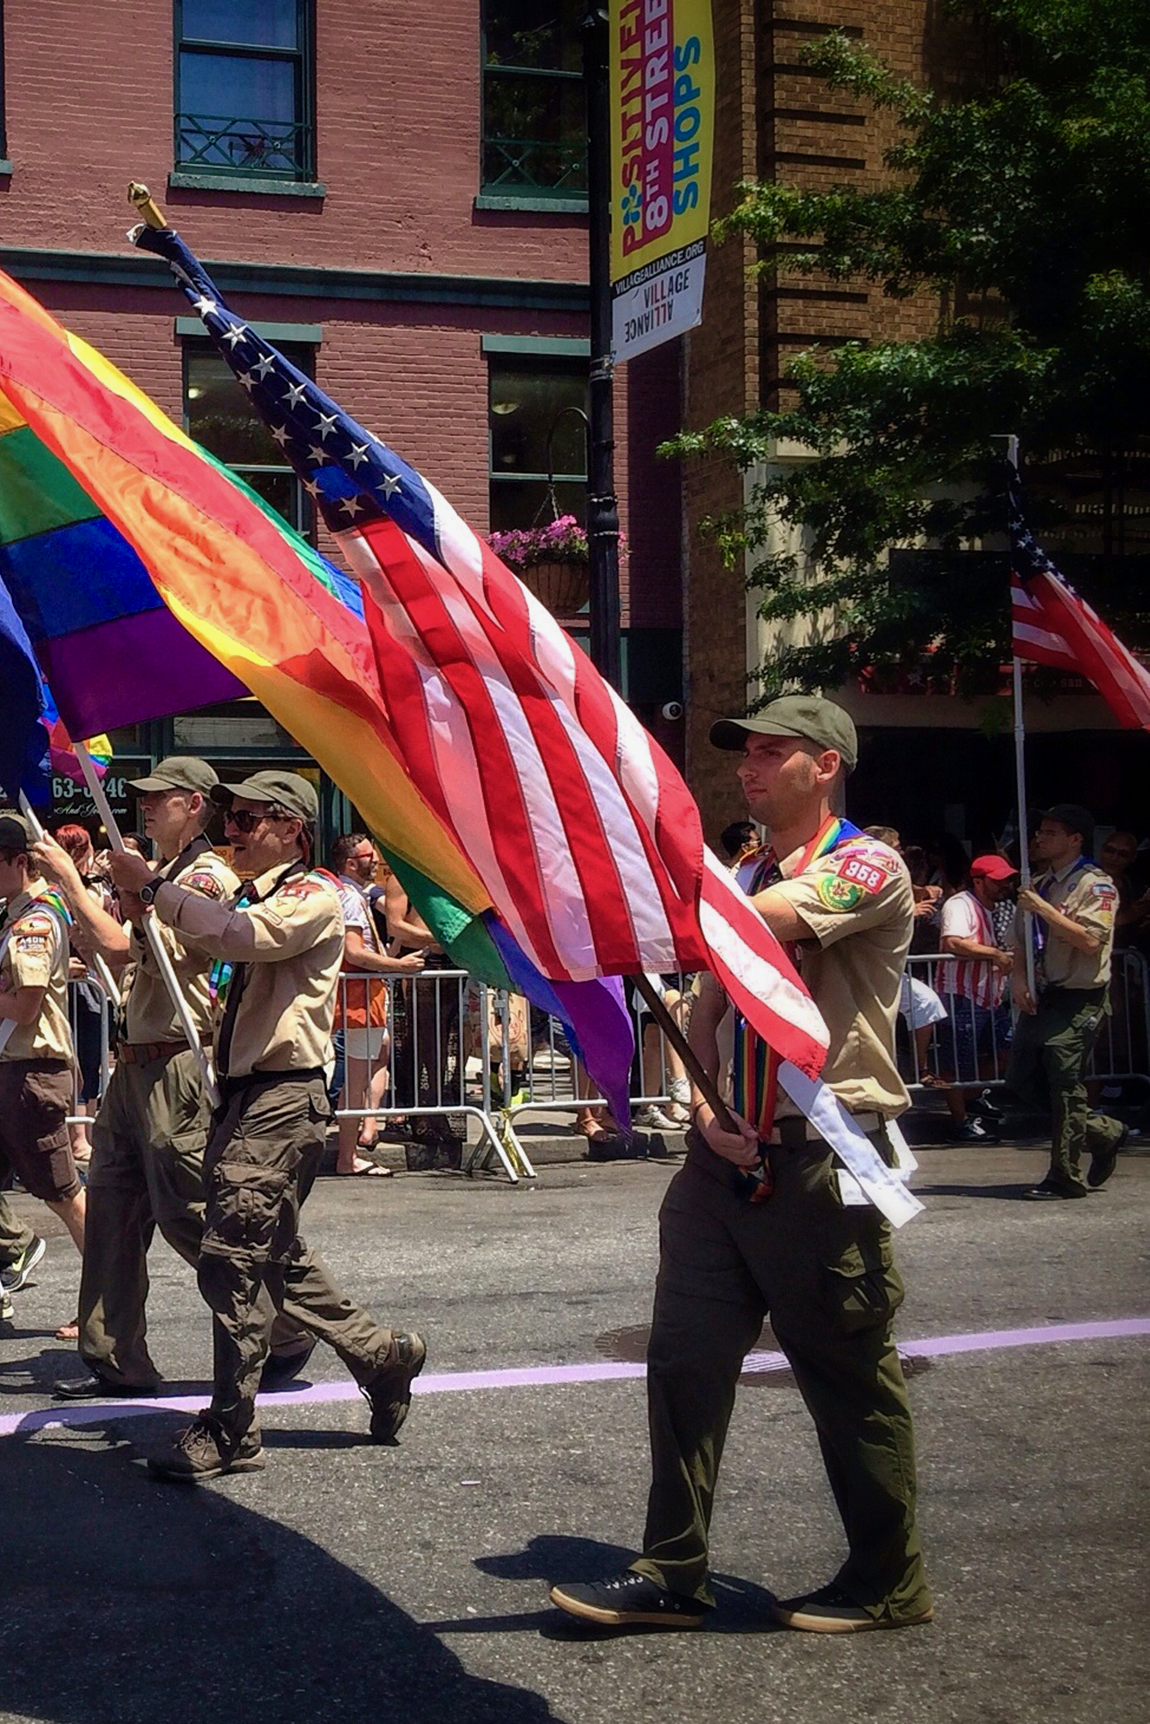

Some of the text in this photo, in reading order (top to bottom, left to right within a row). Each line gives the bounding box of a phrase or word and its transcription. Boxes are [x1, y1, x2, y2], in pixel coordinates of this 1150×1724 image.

[673, 36, 700, 215] SHOPS
[645, 159, 668, 230] 8TH
[615, 240, 704, 294] VILLAGEALLIANCE.ORG
[644, 268, 691, 308] VILLAGE
[625, 299, 674, 343] ALLIANCE
